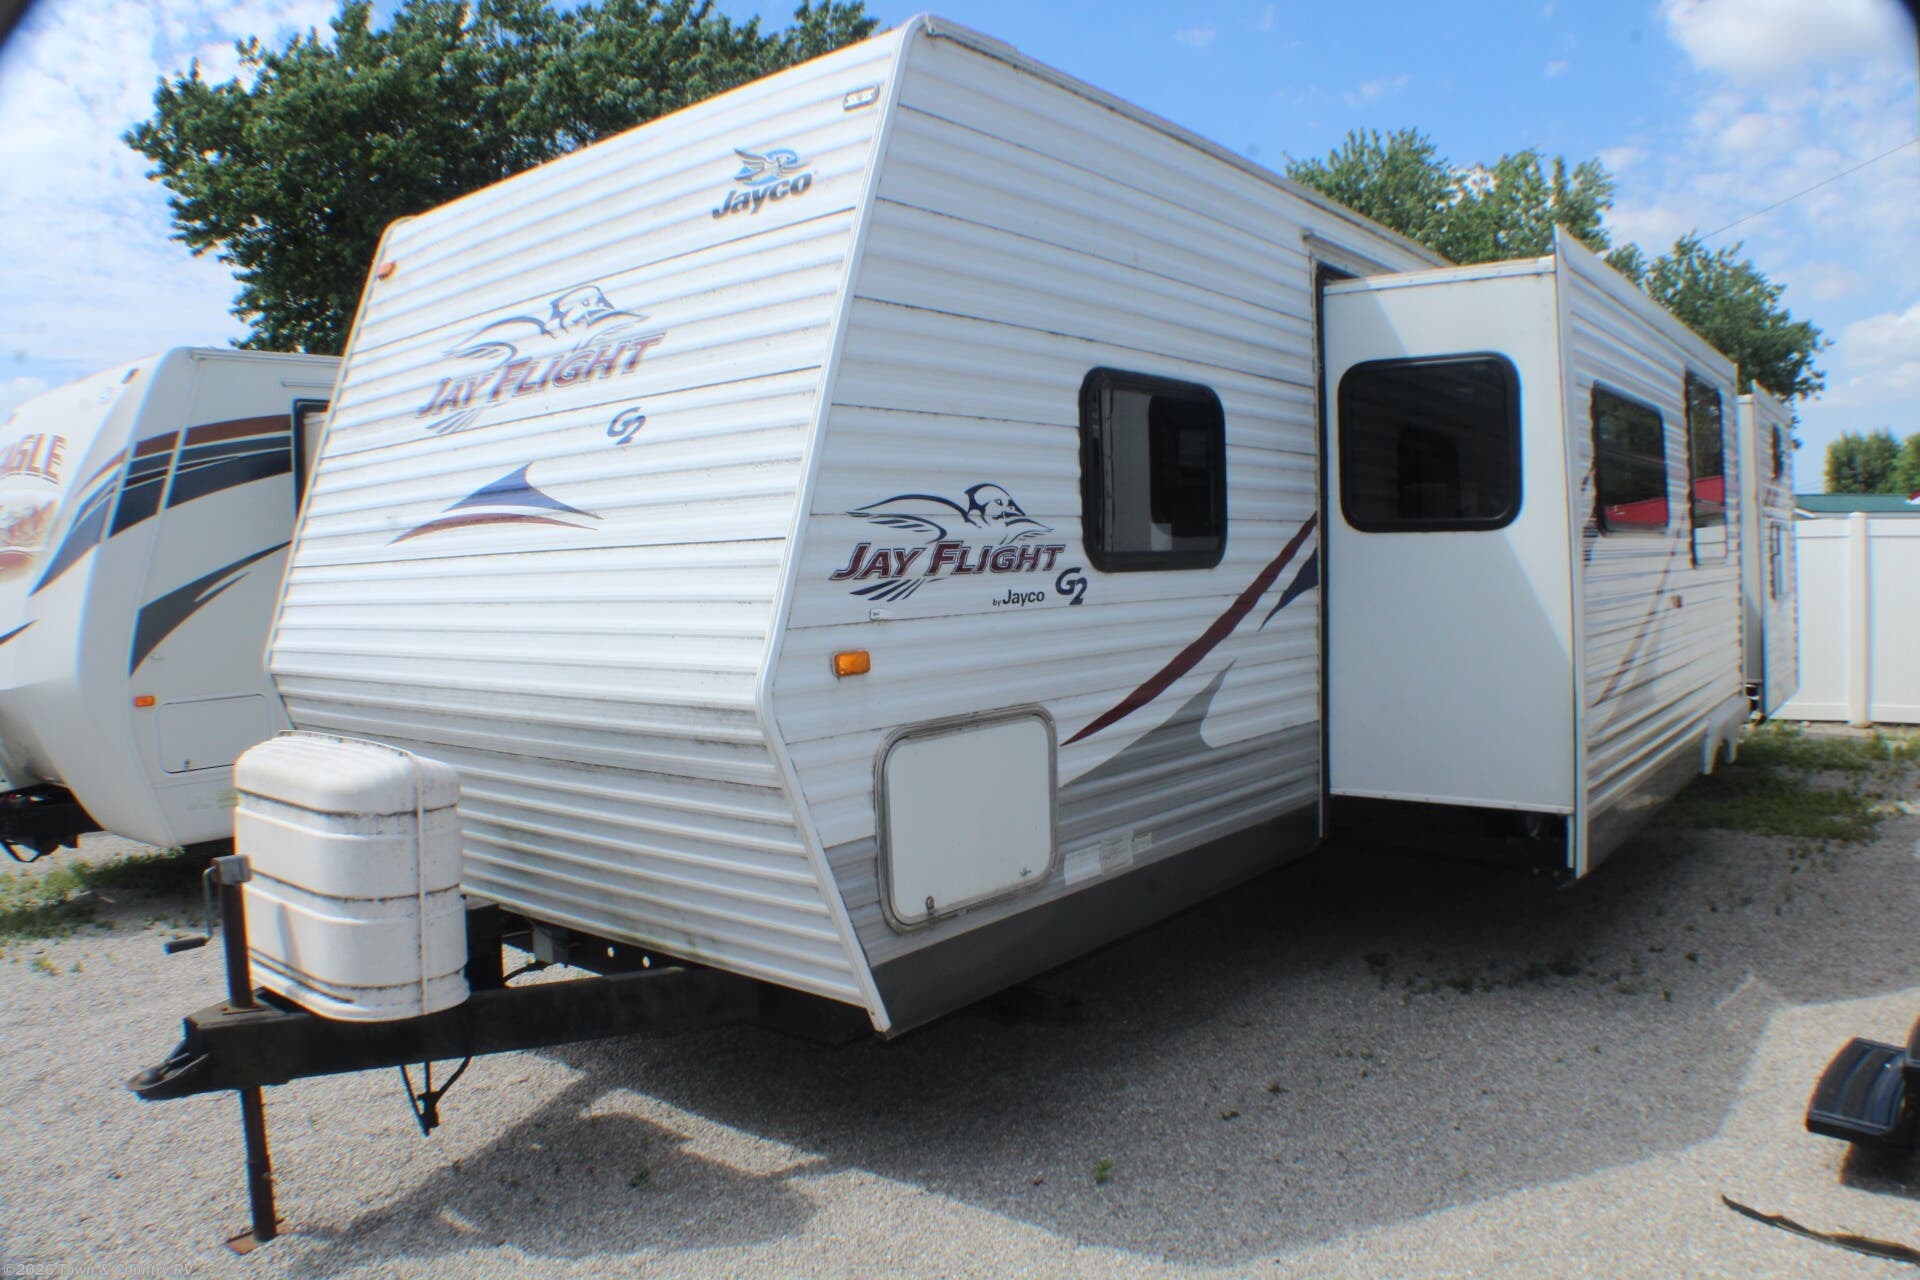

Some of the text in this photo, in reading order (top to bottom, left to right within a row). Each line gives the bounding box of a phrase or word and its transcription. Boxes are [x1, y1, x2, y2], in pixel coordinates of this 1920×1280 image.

[711, 173, 813, 219] Jayco
[416, 332, 667, 419] JAY FLIGHT
[606, 406, 646, 445] G2
[830, 540, 1066, 581] JAY FLIGHT
[992, 589, 1045, 607] by Jayco
[1055, 567, 1088, 605] G2
